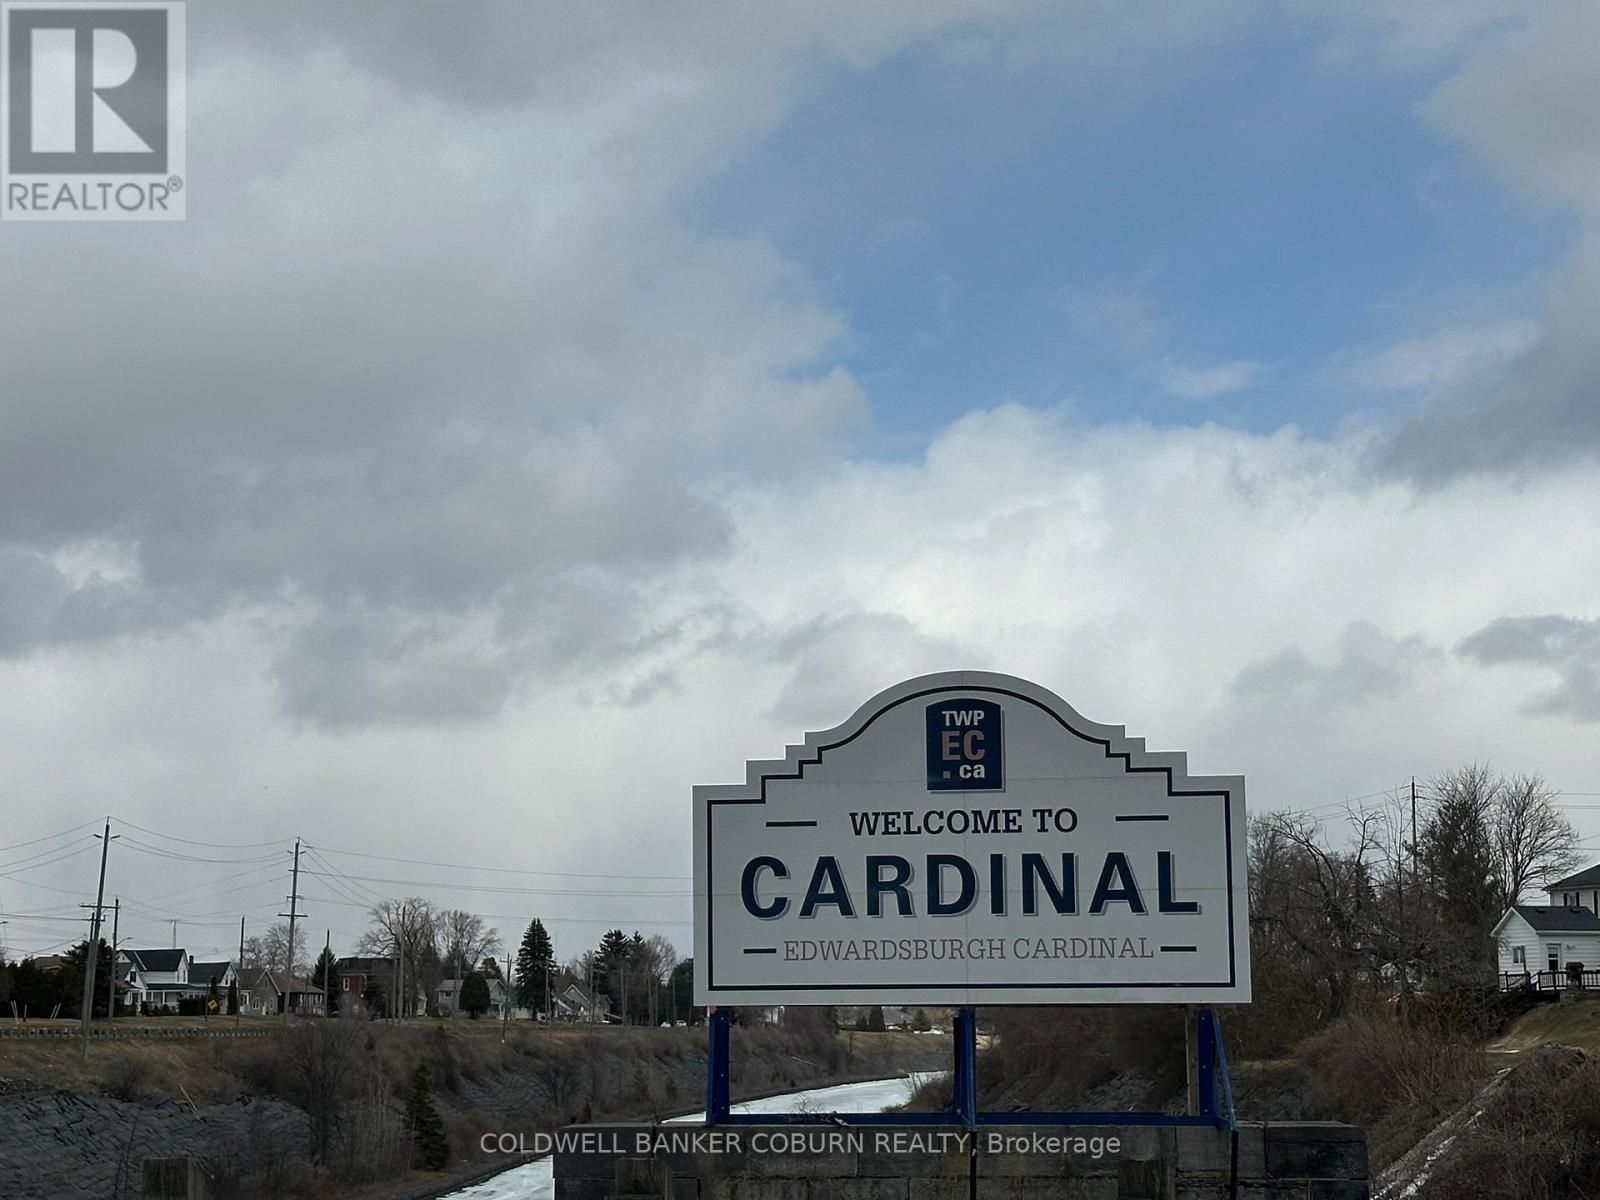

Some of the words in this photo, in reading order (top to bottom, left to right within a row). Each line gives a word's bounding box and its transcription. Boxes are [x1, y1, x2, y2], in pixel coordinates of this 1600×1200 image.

[941, 710, 985, 727] TWP
[941, 730, 985, 761] EC
[849, 809, 1022, 836] WELCOME
[1032, 808, 1078, 833] TO
[741, 851, 1201, 919] CARDINAL
[783, 938, 1006, 962] EDWARDSBURGH
[1013, 937, 1154, 959] CARDINAL
